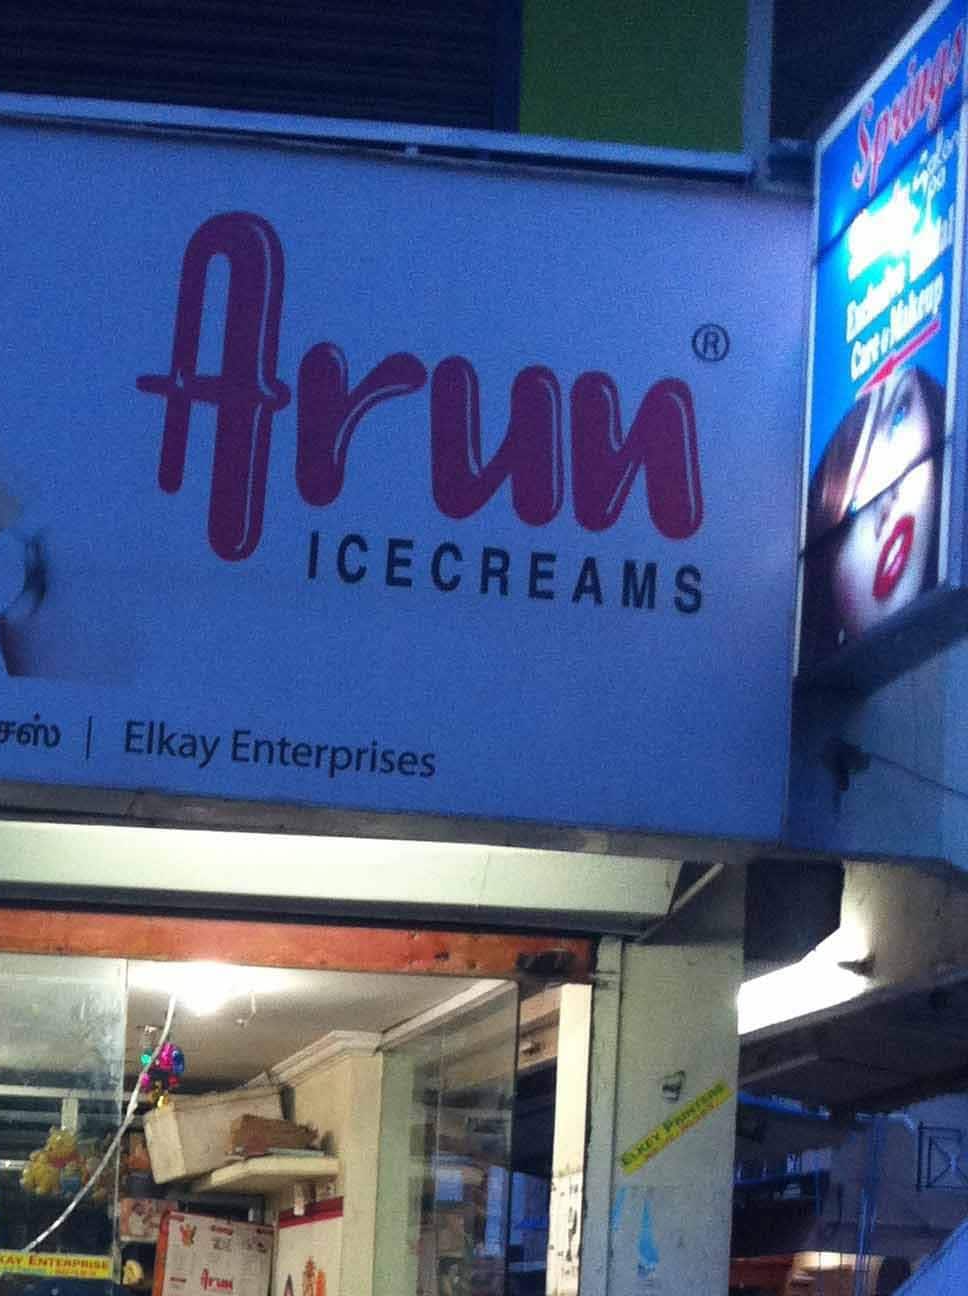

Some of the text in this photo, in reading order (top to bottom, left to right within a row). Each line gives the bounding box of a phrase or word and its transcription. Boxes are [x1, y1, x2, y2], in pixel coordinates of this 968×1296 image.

[136, 211, 704, 562] Arun
[307, 531, 704, 615] ICECREAMS
[125, 719, 436, 778] Elkay Enterprises
